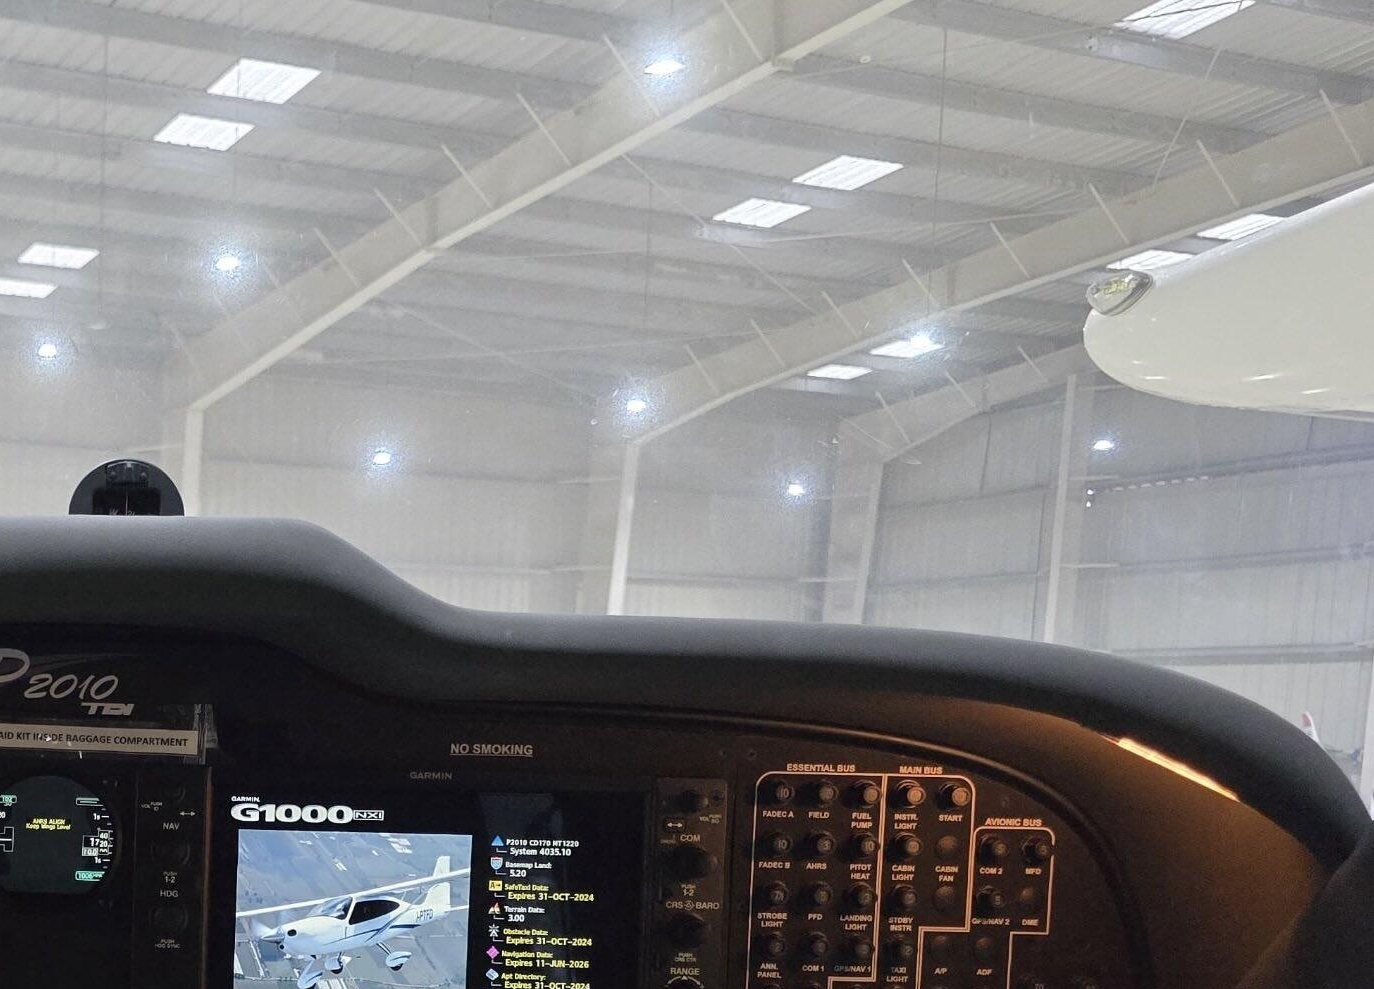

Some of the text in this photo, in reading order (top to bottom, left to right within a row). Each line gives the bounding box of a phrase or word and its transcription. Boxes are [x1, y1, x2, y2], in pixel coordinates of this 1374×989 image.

[16, 732, 31, 740] KIT
[66, 735, 111, 743] BAGGAGE
[114, 737, 188, 746] COMPARTMENT
[451, 744, 533, 755] NO SMOKING
[787, 764, 855, 772] ESSENTIAL BUS
[900, 766, 922, 774] MAIN
[410, 771, 452, 780] GARMIN
[231, 803, 353, 824] G1000
[985, 818, 1021, 826] AVIONIC
[538, 893, 594, 901] 31-OCT-2024
[537, 938, 592, 946] 31-OCT-2024
[535, 982, 590, 989] 31-OCT-2024
